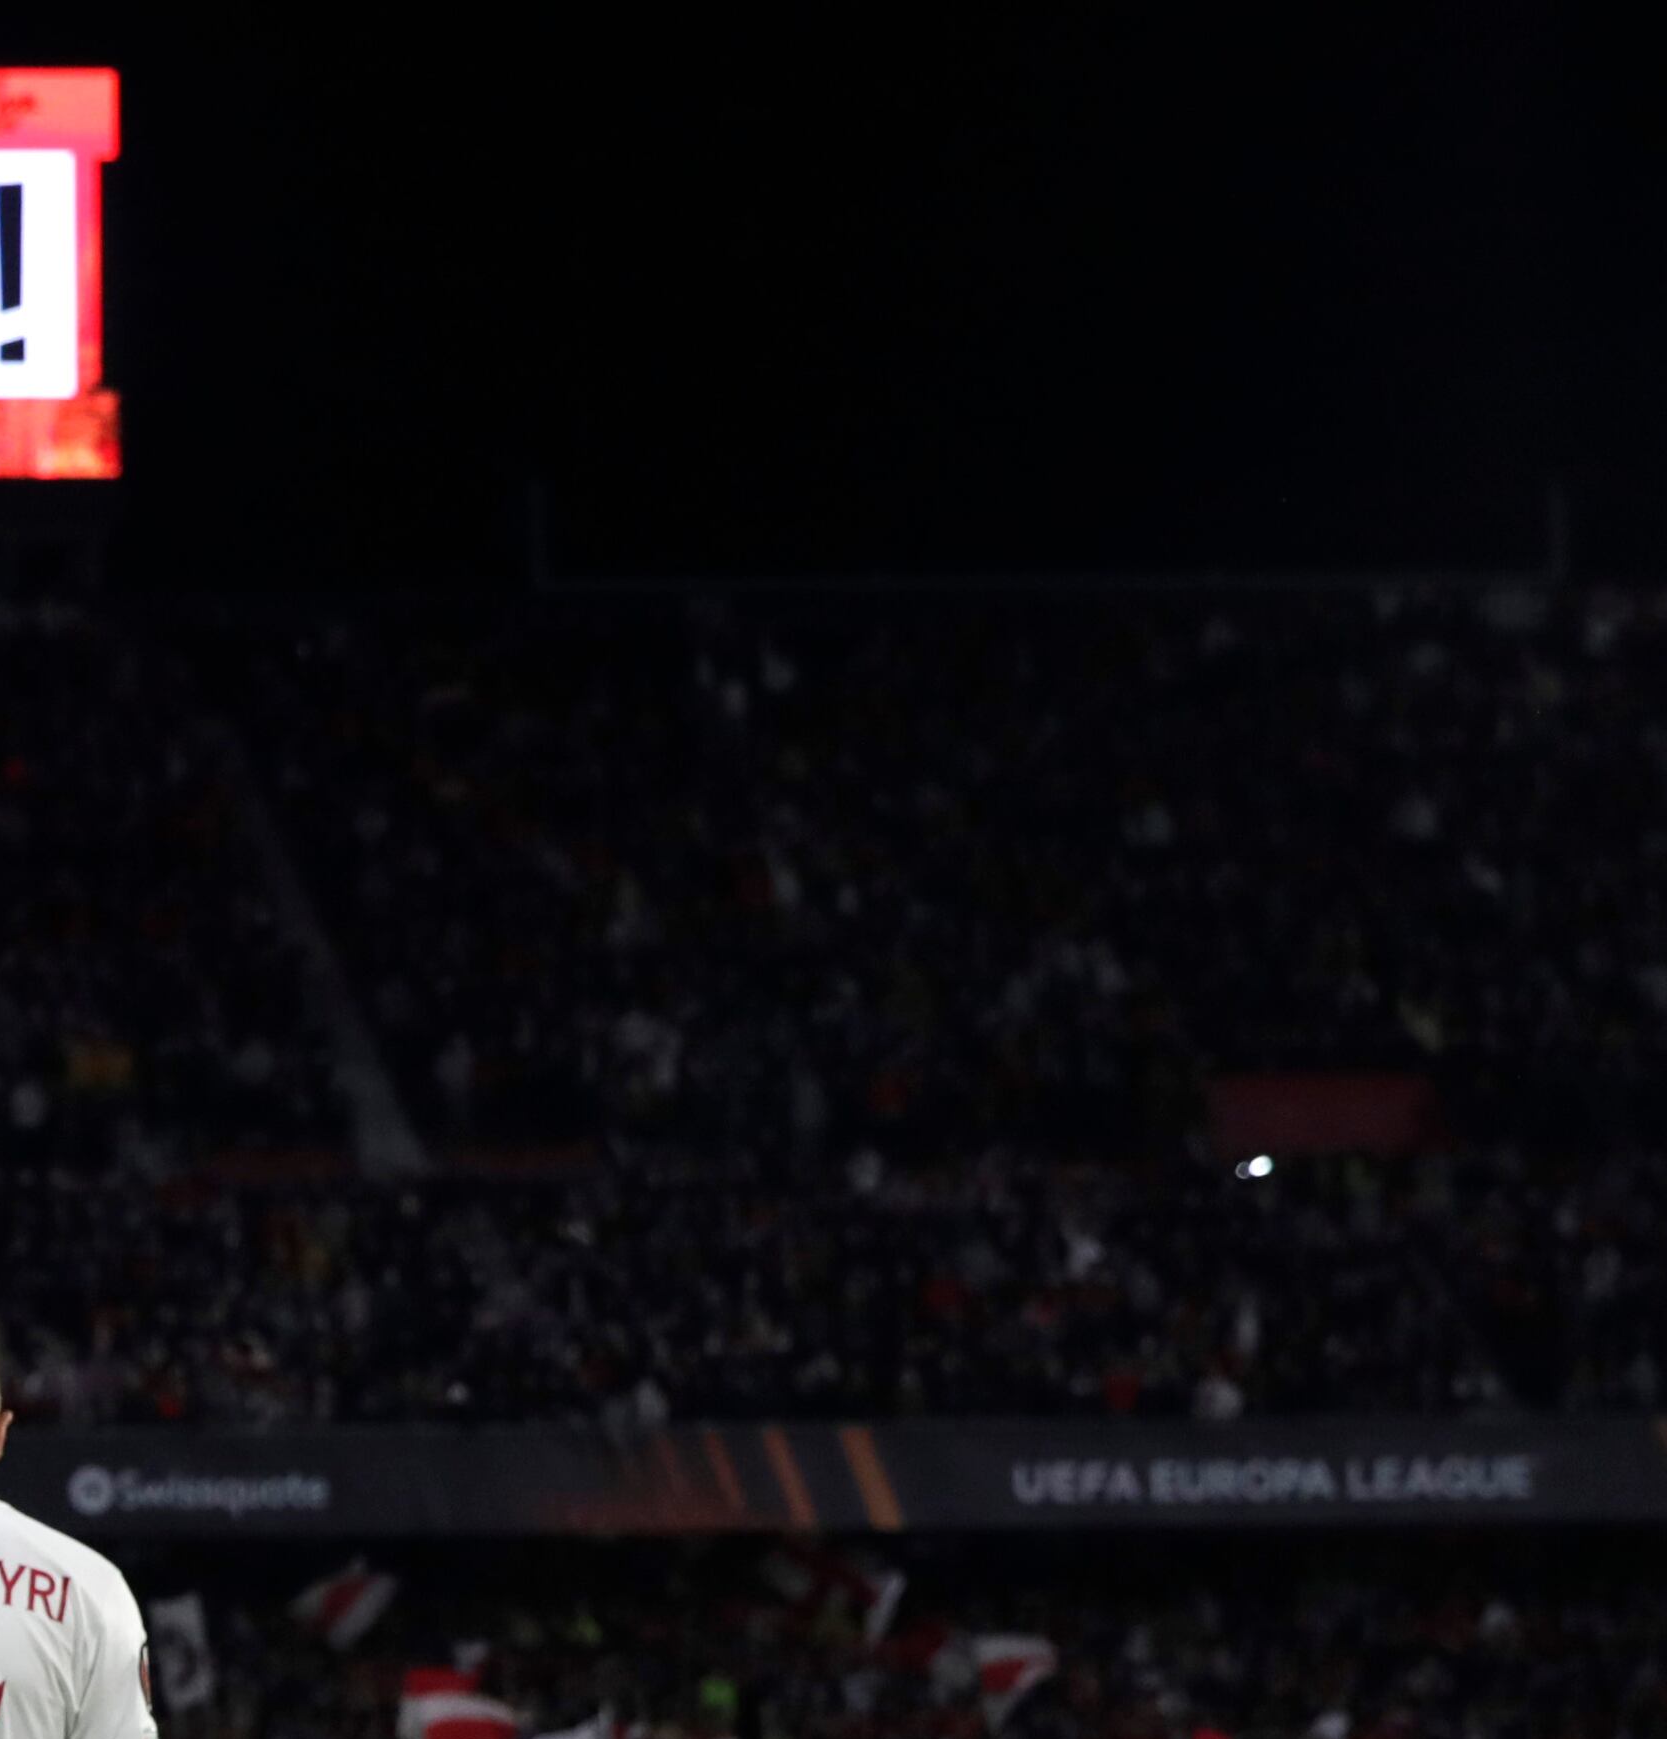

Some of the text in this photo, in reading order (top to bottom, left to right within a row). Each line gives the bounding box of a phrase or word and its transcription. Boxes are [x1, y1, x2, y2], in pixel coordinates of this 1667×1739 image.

[1012, 1457, 1532, 1503] UEFA EUROPA LEAGUE
